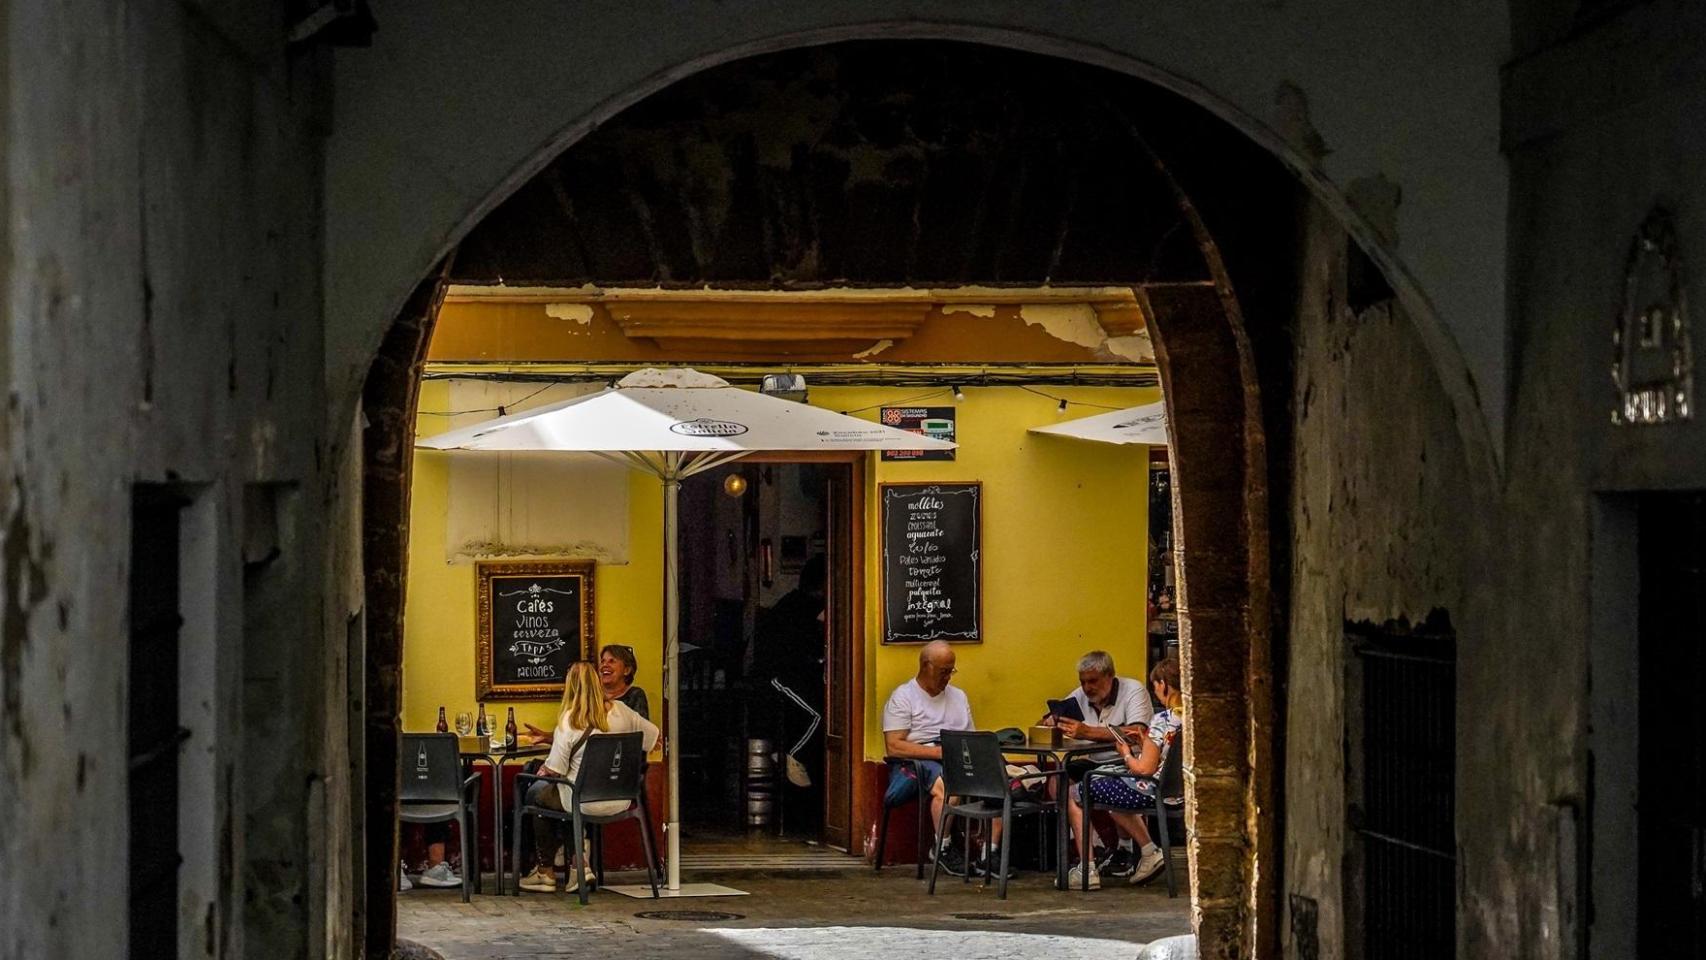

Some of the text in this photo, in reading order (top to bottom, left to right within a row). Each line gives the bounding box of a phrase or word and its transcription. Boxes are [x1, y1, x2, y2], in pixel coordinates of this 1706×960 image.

[517, 599, 554, 613] Cafés
[513, 629, 559, 638] cerveza
[520, 643, 553, 655] TAPAS
